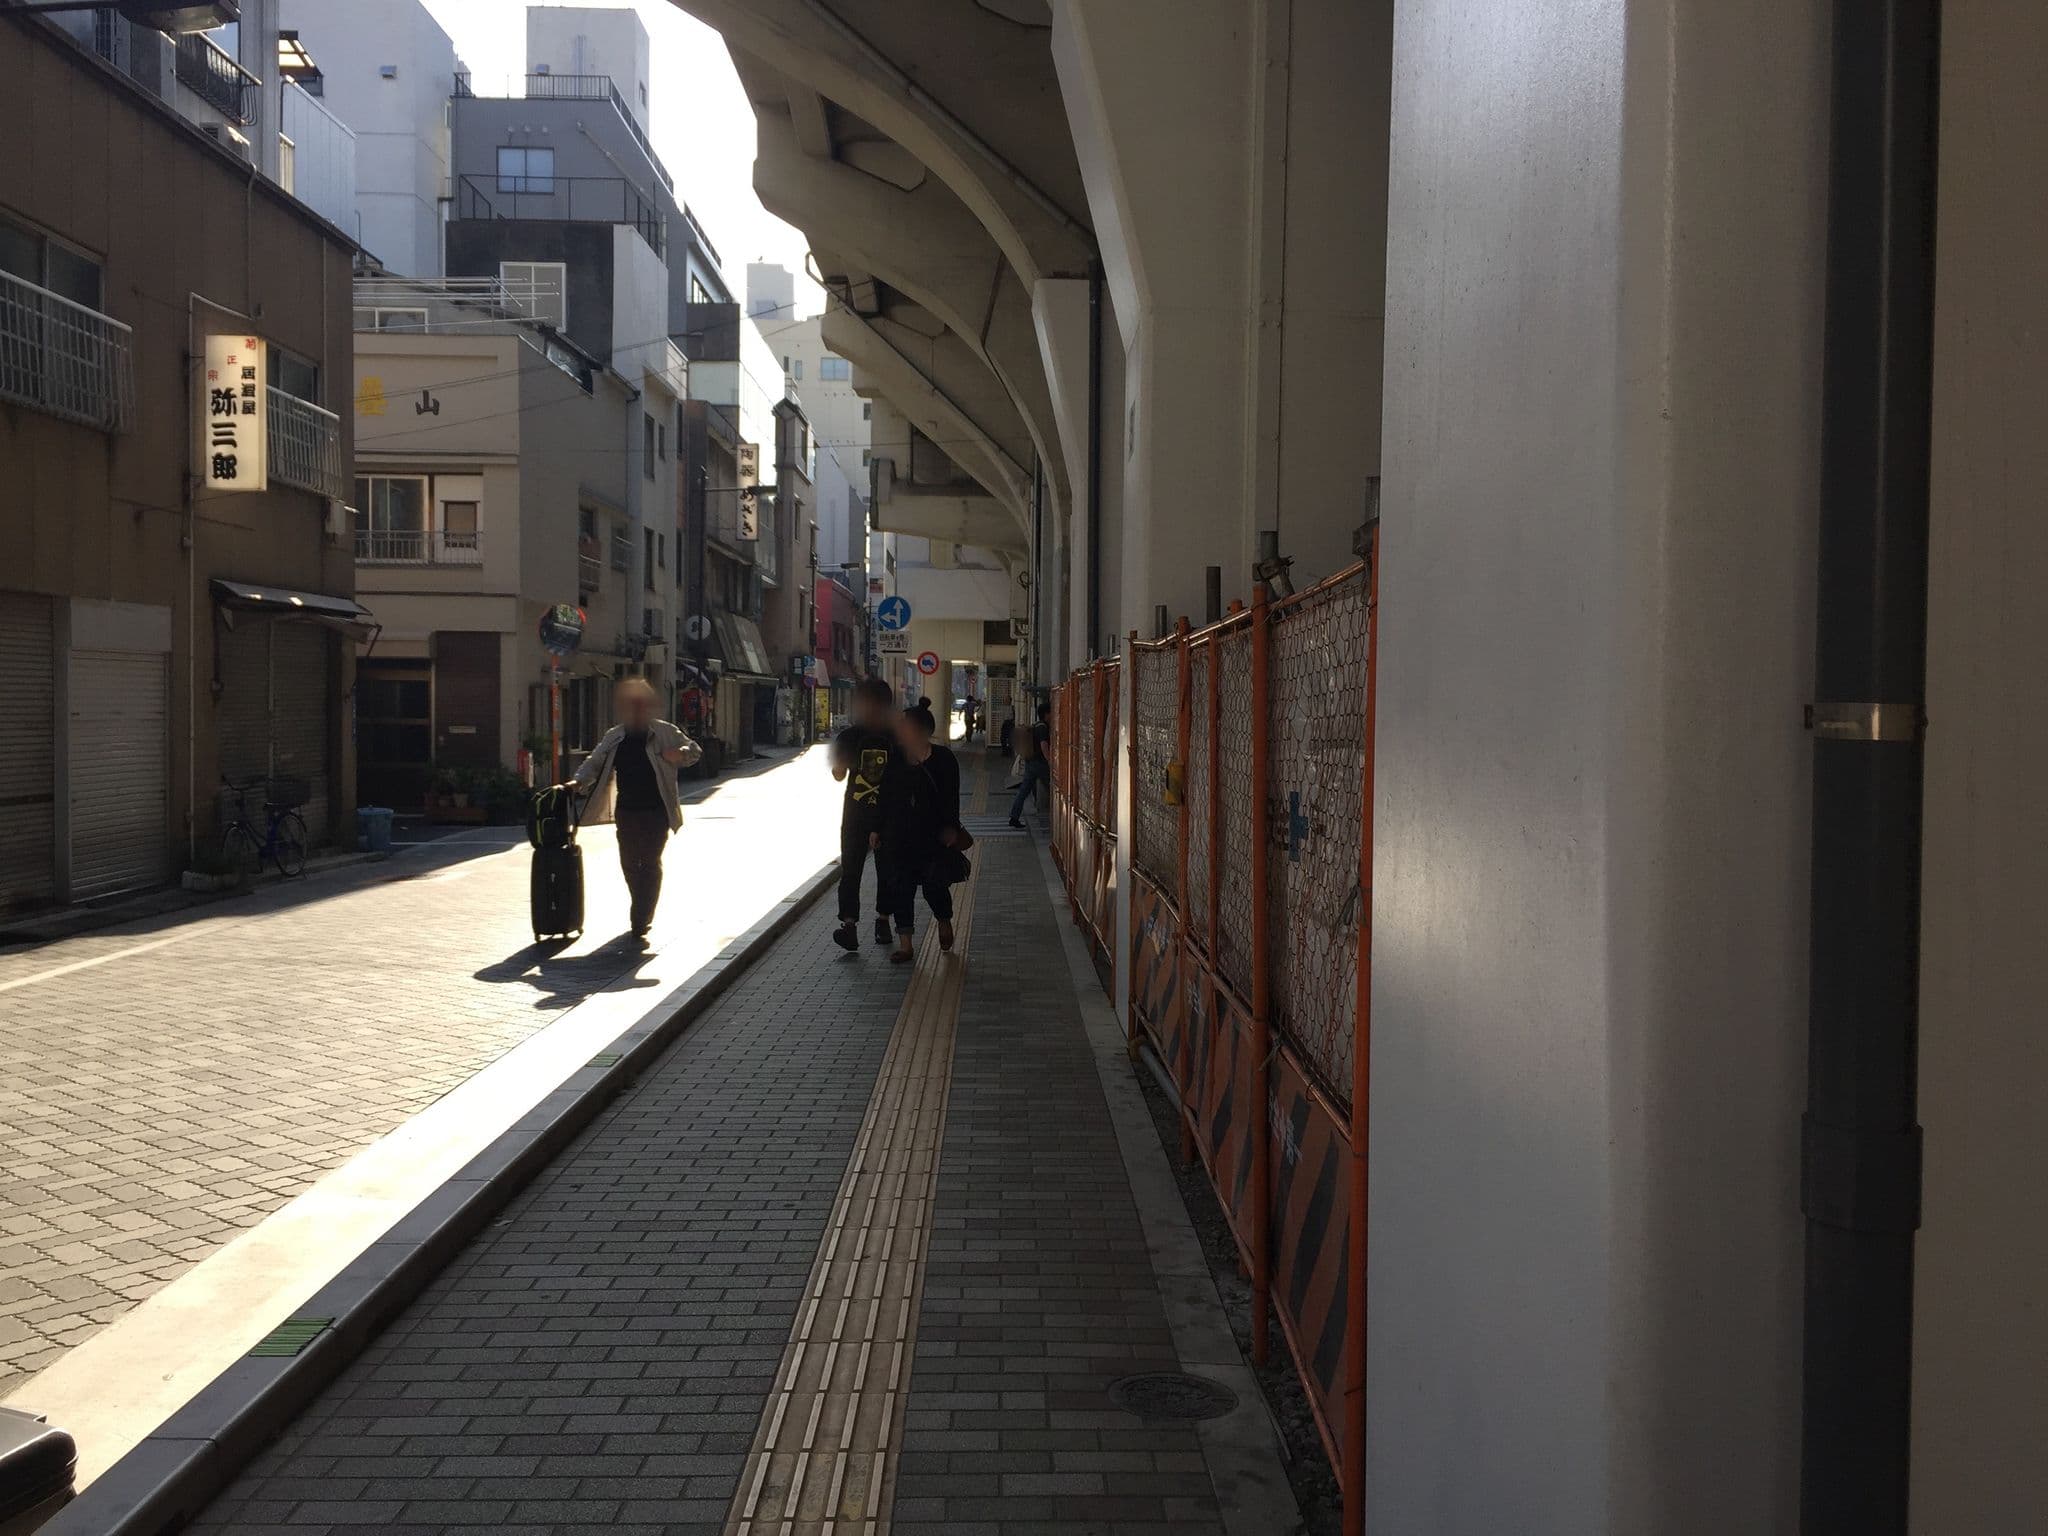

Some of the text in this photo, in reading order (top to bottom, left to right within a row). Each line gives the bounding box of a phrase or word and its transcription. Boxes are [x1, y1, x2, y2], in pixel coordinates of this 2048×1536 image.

[241, 366, 256, 415] 居酒屋
[211, 387, 237, 480] 弥三郎
